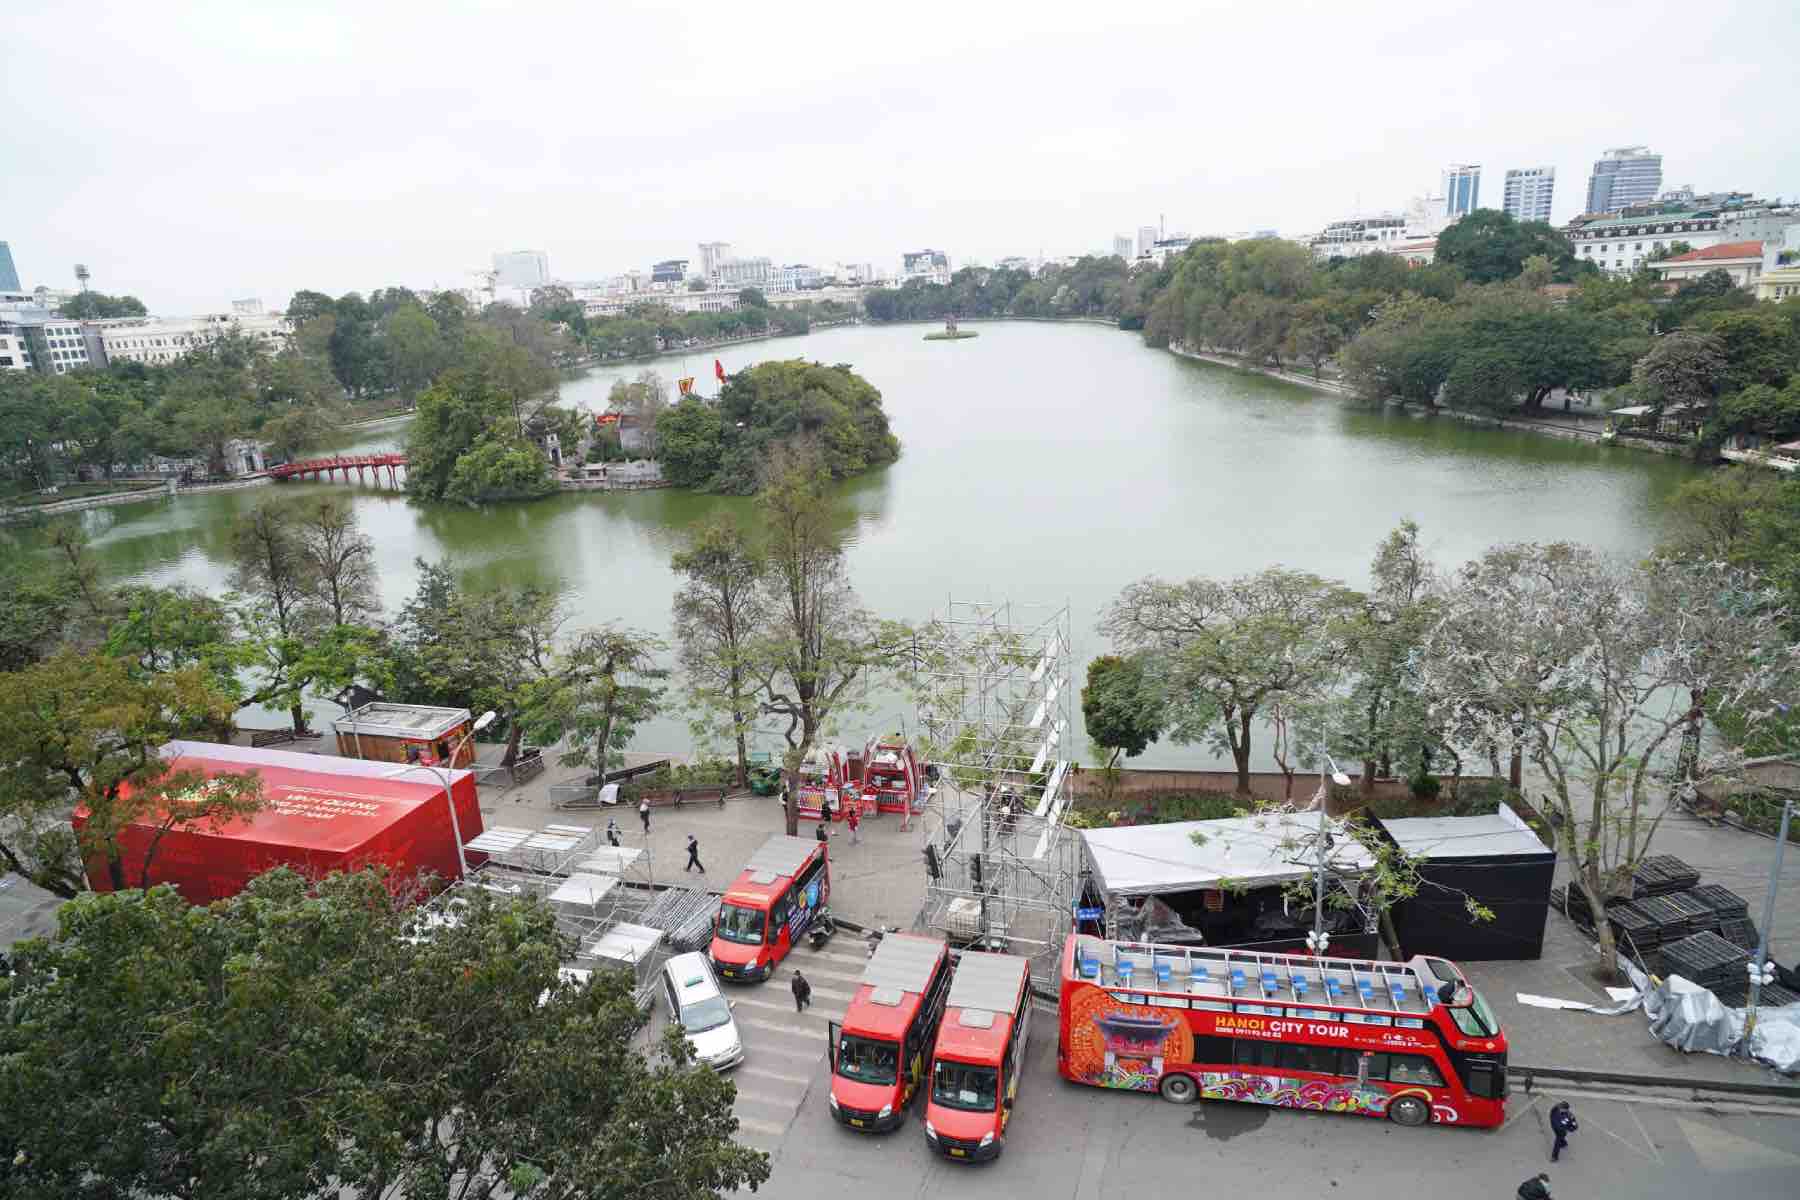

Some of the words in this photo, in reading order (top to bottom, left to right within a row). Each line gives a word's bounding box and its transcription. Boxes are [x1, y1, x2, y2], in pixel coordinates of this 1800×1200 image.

[1216, 1017, 1265, 1030] HANOI
[1270, 1021, 1304, 1034] CITY
[1309, 1024, 1349, 1038] TOUR
